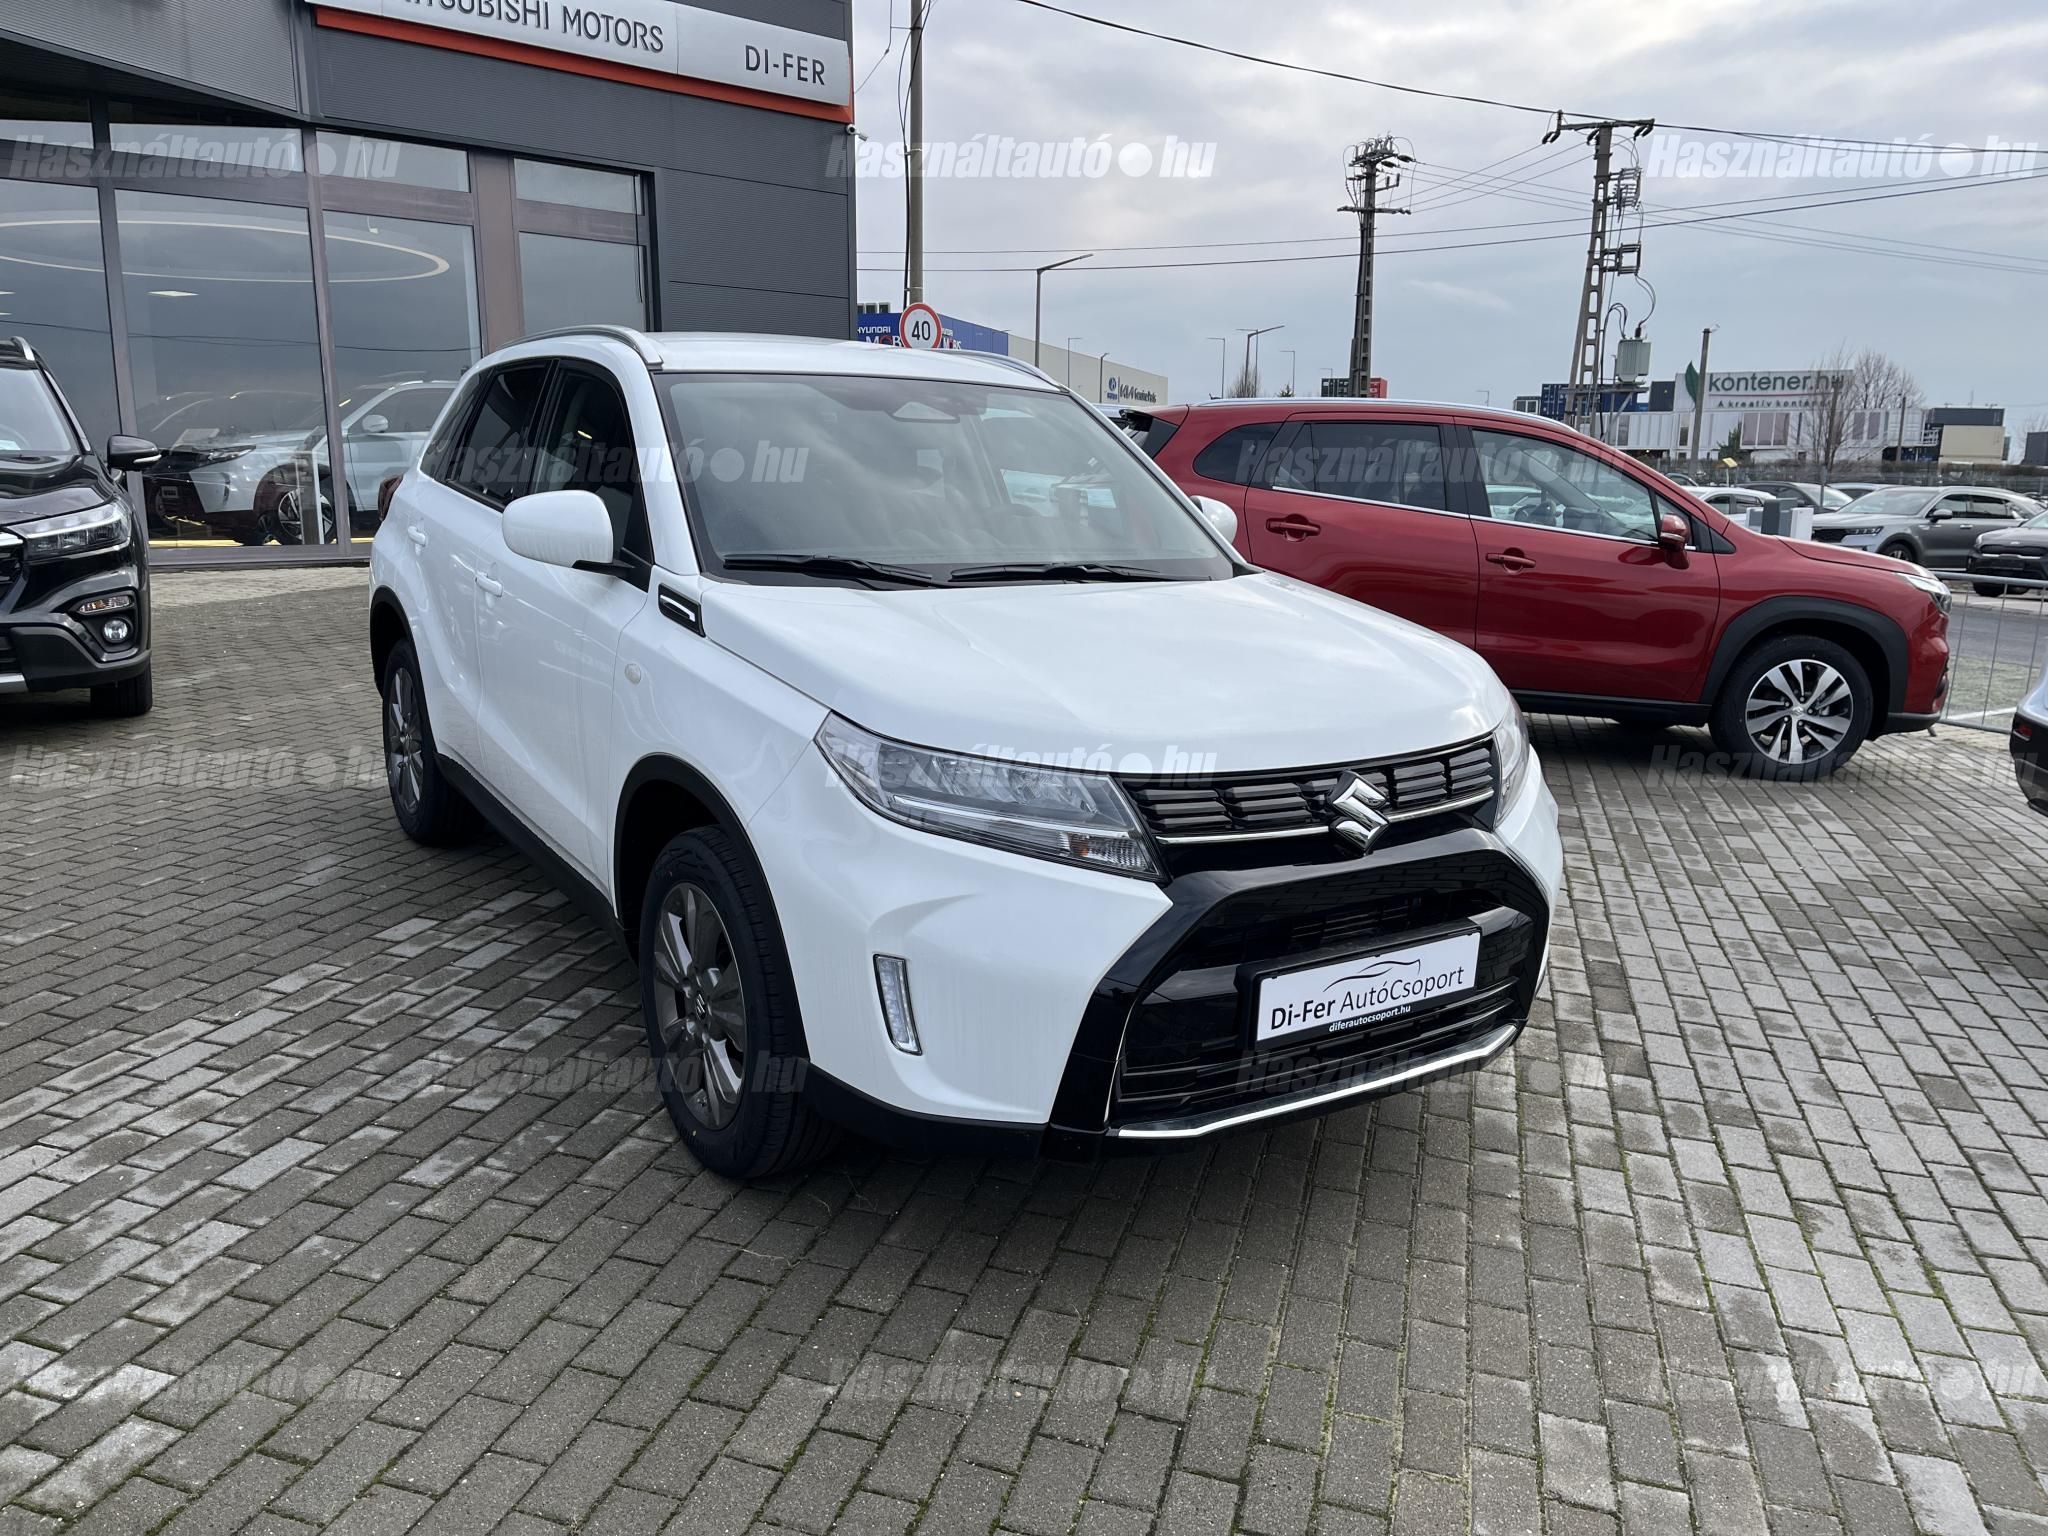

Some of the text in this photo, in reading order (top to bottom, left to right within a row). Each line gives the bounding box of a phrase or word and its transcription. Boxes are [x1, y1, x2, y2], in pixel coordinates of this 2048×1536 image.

[562, 5, 664, 52] MOTORS
[745, 44, 825, 86] DI-FER
[911, 320, 931, 341] 40
[1271, 966, 1464, 1030] Di-Fer AutóCsoport
[1329, 1004, 1411, 1032] diferautocsoport.hu
